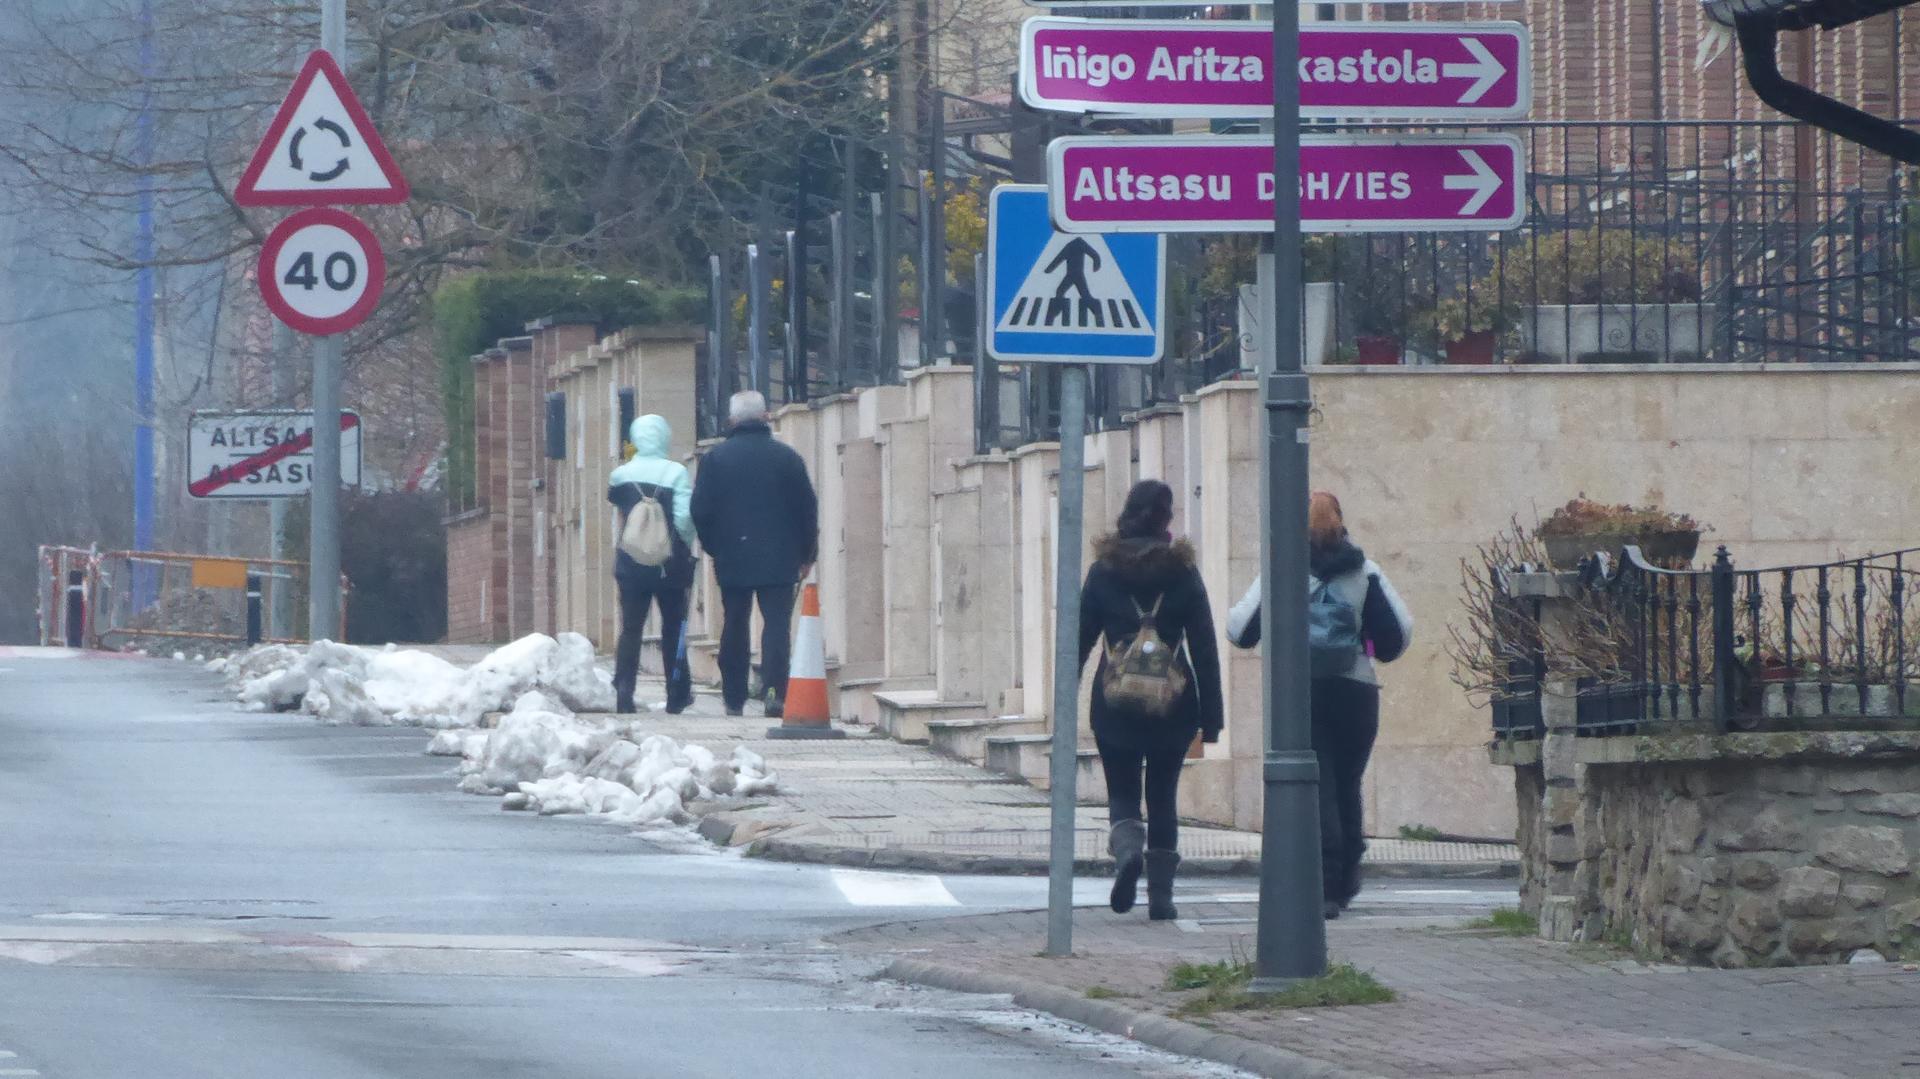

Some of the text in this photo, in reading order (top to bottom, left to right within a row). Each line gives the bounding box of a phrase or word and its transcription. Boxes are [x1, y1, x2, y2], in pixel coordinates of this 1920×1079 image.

[1042, 45, 1439, 87] Iñigo Aritza kastola
[1073, 166, 1412, 201] Altsasu DH/IES
[284, 251, 357, 291] 40
